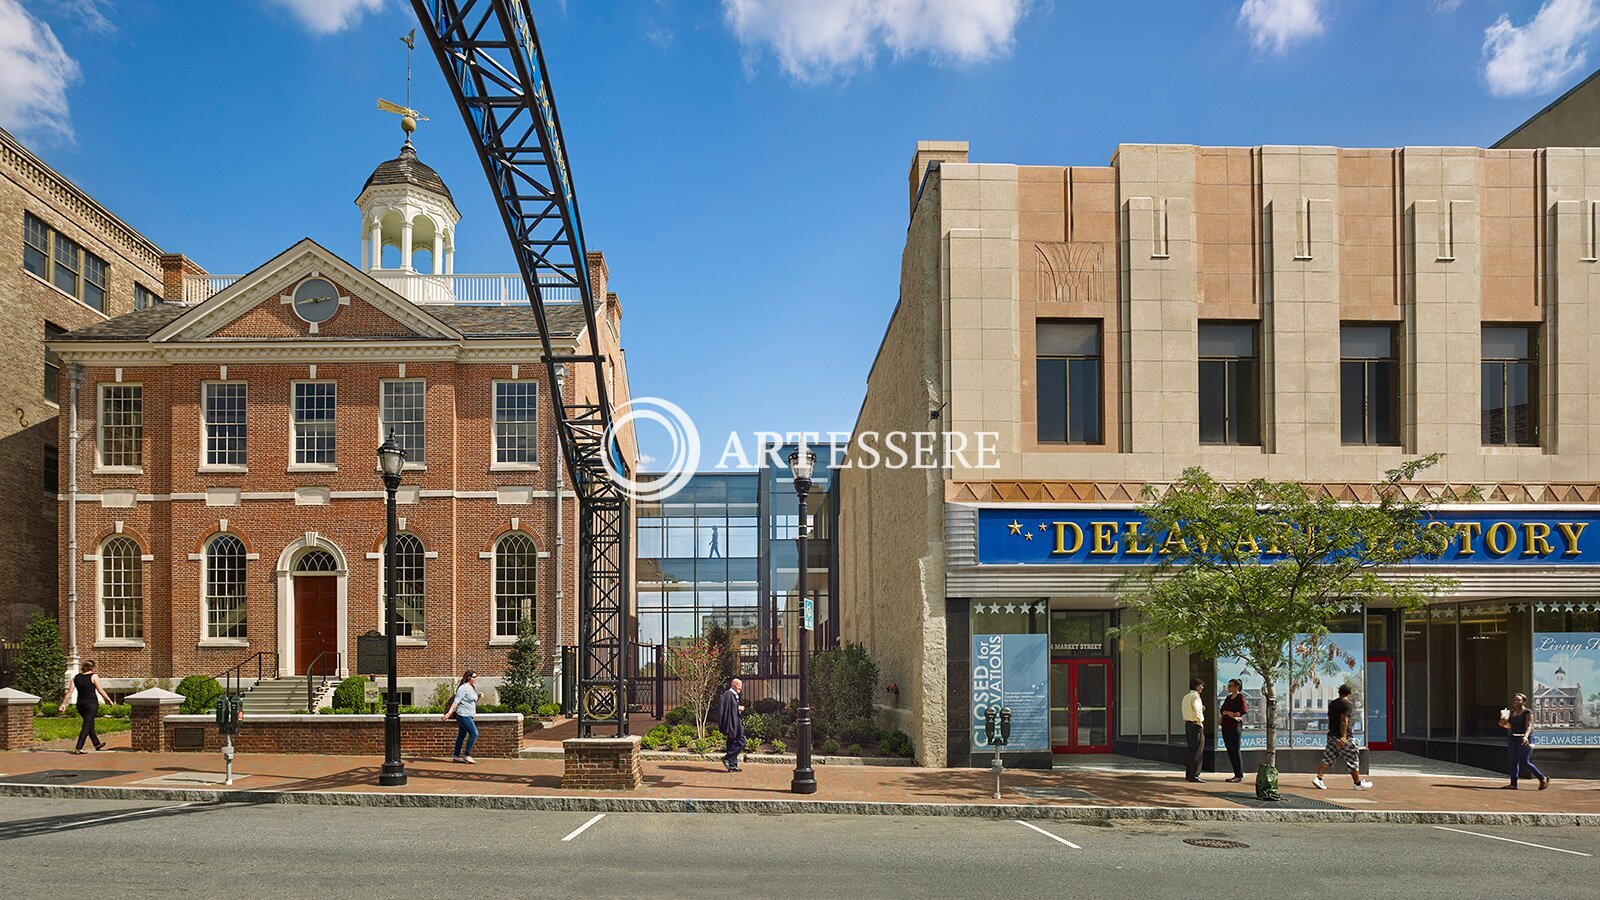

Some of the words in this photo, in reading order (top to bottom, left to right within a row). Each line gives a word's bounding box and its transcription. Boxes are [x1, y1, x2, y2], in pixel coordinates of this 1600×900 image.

[1358, 521, 1588, 556] STORY
[978, 641, 989, 659] for
[1535, 636, 1582, 660] Living
[989, 635, 1002, 743] ENOVATIONS
[1217, 737, 1267, 747] DWARE
[1534, 736, 1582, 744] DELAWARE
